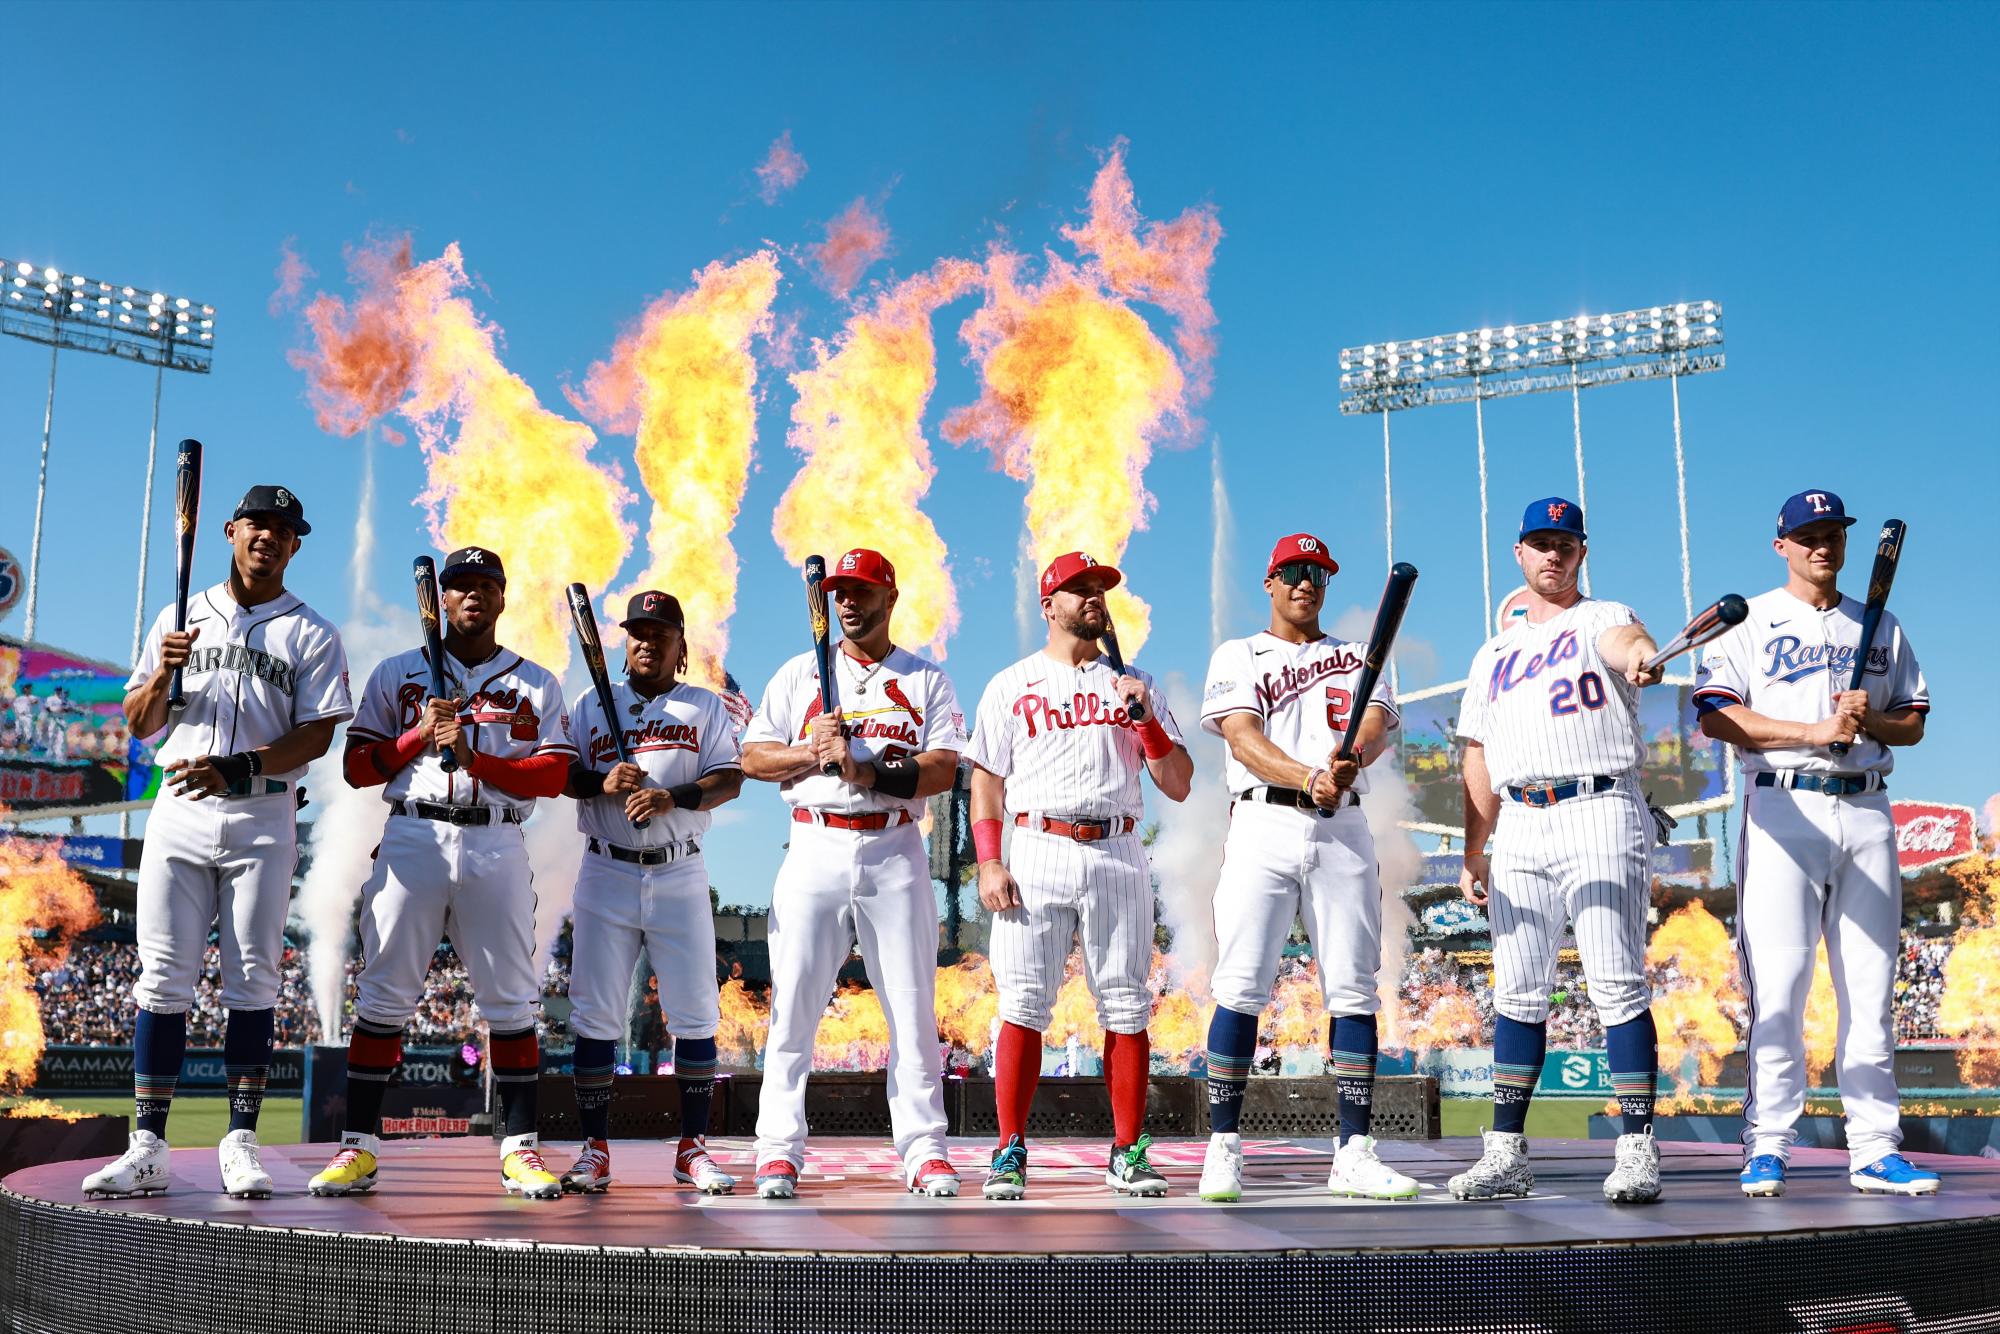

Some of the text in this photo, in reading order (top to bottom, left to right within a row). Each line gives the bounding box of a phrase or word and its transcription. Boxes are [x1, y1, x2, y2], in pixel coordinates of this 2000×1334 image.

[1806, 494, 1826, 513] T
[1298, 538, 1317, 551] W
[466, 550, 482, 563] A
[643, 594, 656, 611] C
[1762, 636, 1889, 677] Rangrs
[182, 642, 293, 697] ARINERS
[1488, 629, 1579, 703] Mets
[1255, 649, 1363, 713] Nationals
[1549, 671, 1607, 717] 20
[187, 1063, 226, 1077] UCLA
[1220, 1089, 1246, 1097] GAM
[1343, 1086, 1369, 1096] STAR
[345, 1137, 360, 1145] NIKE
[520, 1139, 534, 1147] NIKE
